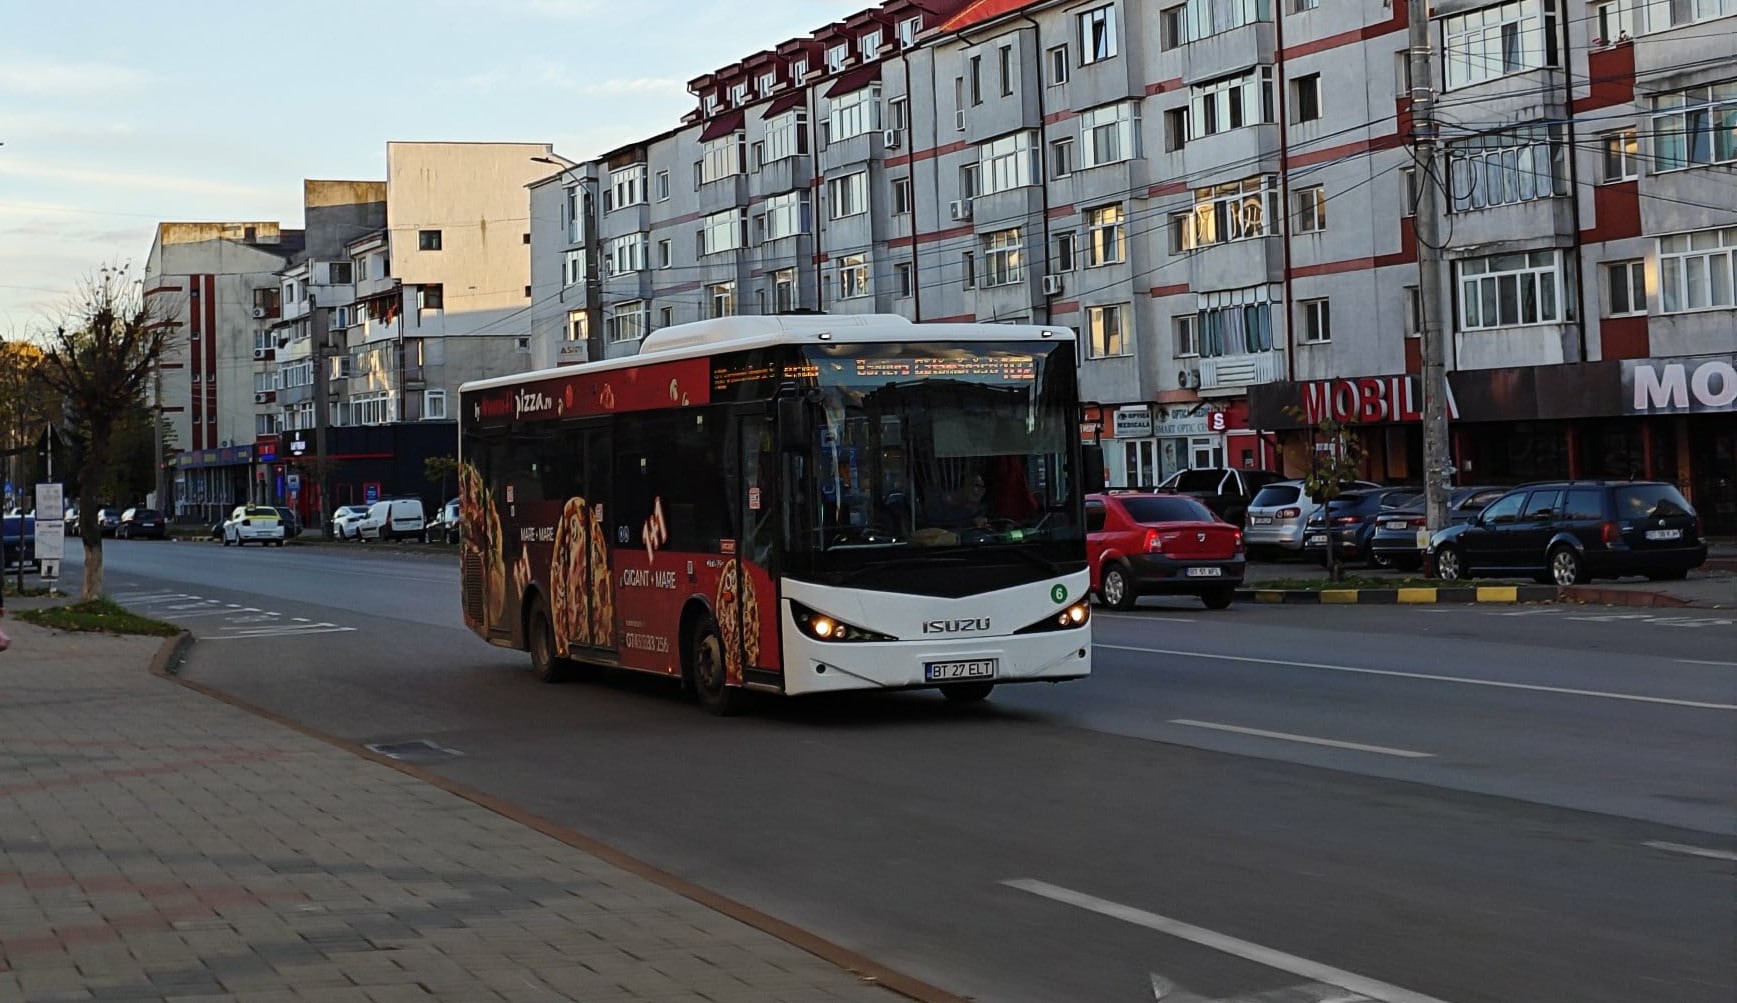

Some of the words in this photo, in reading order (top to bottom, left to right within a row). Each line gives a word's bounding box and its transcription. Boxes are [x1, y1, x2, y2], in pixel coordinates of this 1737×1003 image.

[1633, 361, 1737, 410] MO
[1056, 588, 1063, 599] 6
[922, 617, 991, 634] ISUZU
[933, 665, 947, 677] BT
[952, 664, 965, 676] 27
[968, 663, 990, 675] ELT
